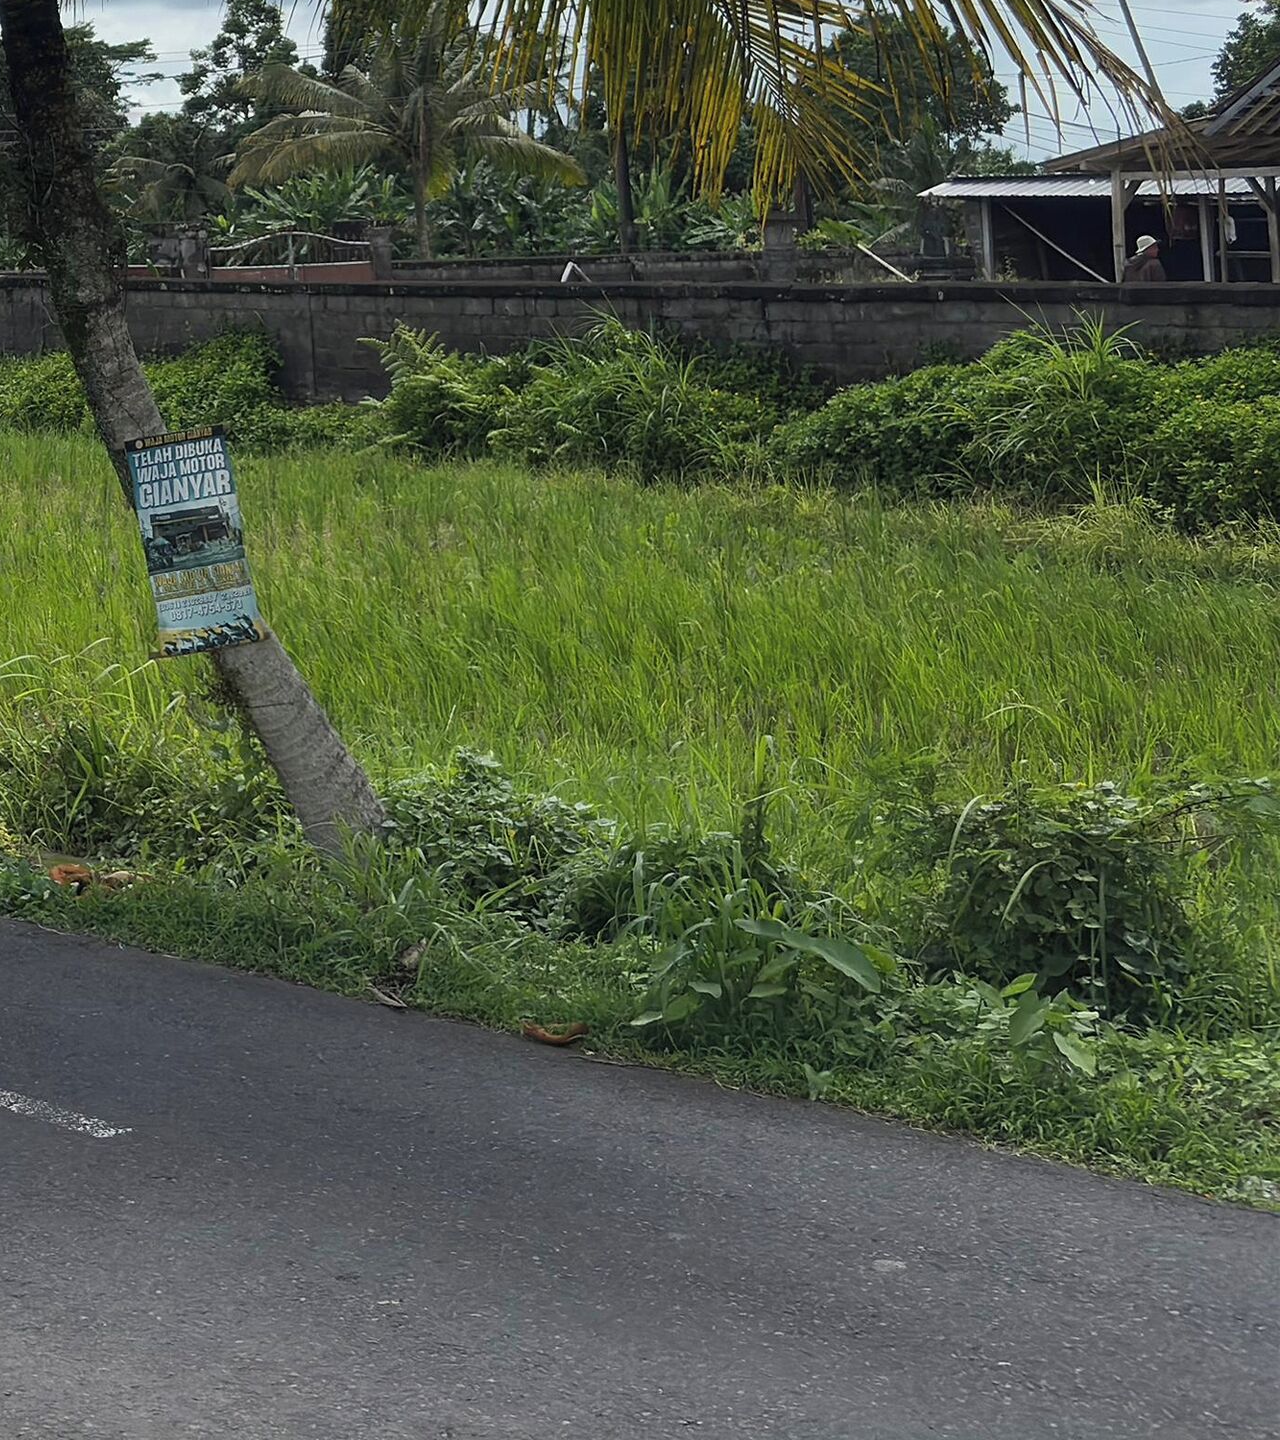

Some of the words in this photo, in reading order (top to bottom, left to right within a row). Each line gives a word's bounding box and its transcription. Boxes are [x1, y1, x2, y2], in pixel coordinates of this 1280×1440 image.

[132, 446, 172, 467] TELAH
[175, 438, 223, 460] DIBUKA
[137, 462, 177, 483] WAJA
[180, 453, 225, 475] MOTOR
[139, 469, 232, 509] GIANYAR
